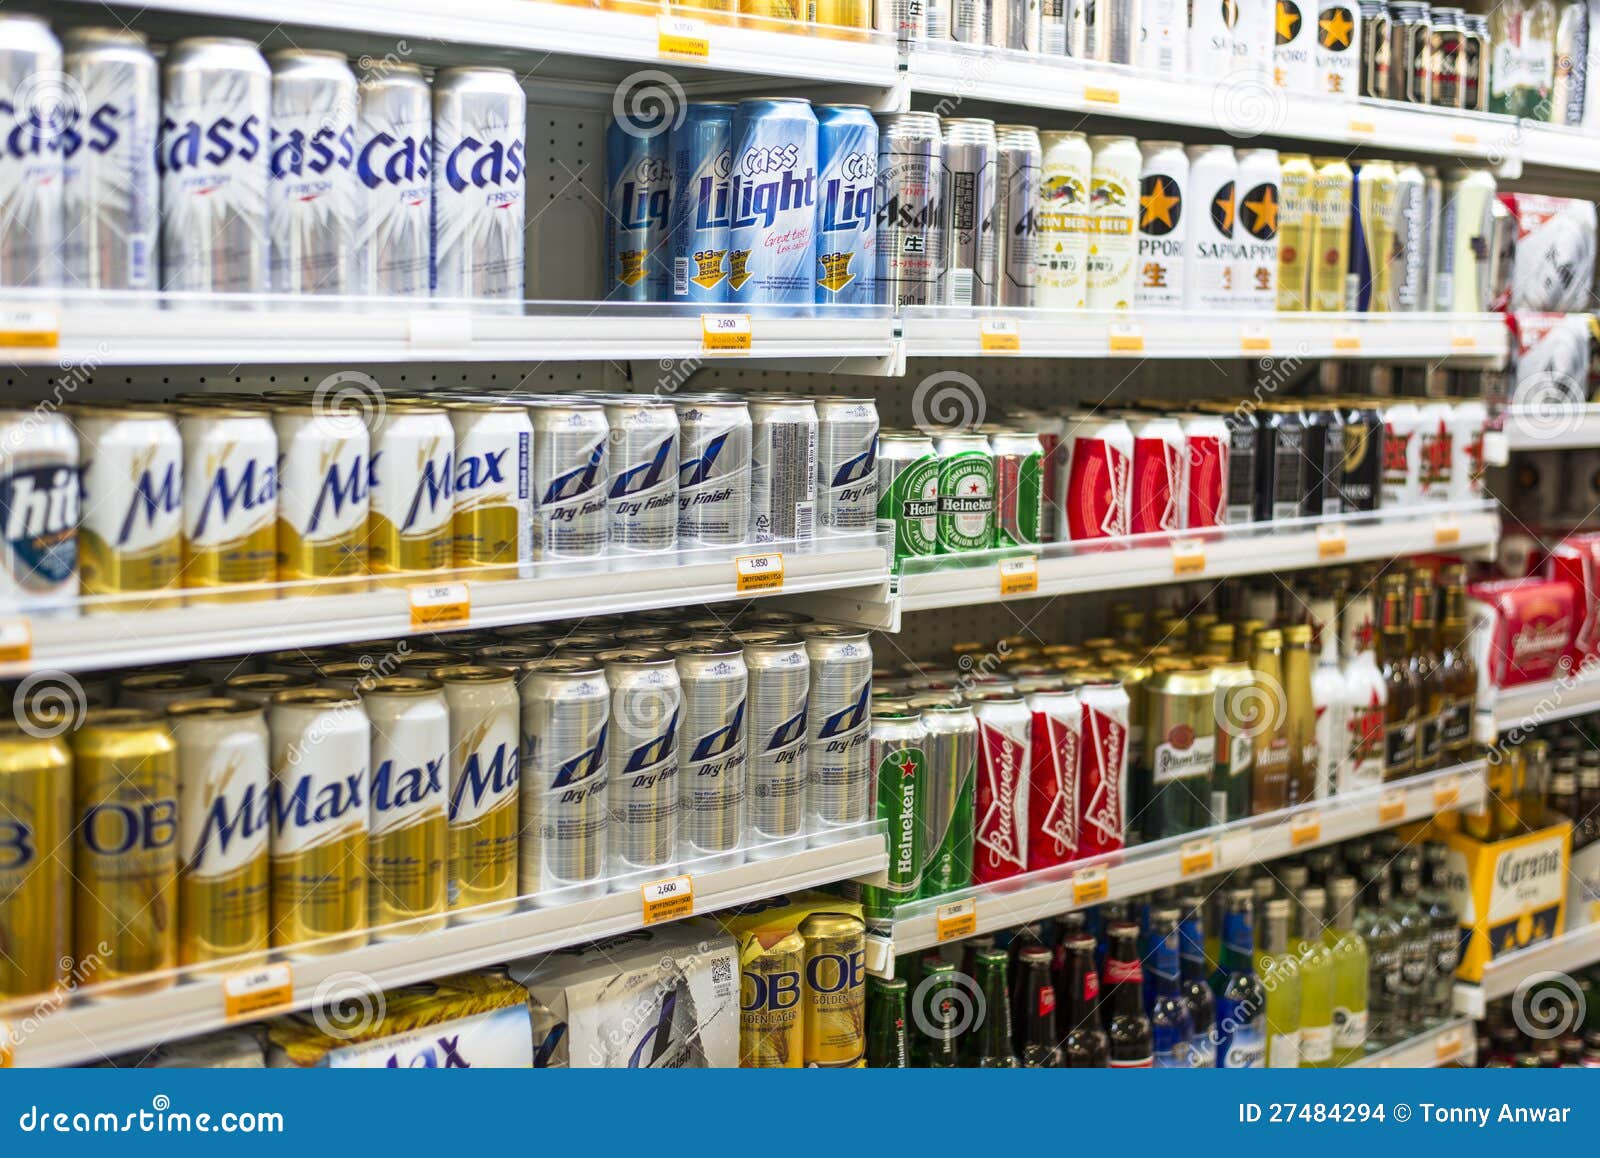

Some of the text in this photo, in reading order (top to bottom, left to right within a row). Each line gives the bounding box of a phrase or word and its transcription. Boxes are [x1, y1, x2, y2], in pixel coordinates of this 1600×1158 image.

[730, 167, 817, 231] Light
[904, 235, 924, 252] 生
[1142, 261, 1168, 288] 生
[717, 319, 736, 329] 2,600
[693, 487, 731, 505] Finish
[839, 488, 860, 502] Dry
[616, 500, 641, 517] Dry
[942, 498, 993, 512] Heineken
[551, 505, 576, 522] Dry
[750, 558, 769, 568] 1,850
[825, 739, 848, 753] Dry
[774, 749, 795, 764] Dry
[697, 763, 721, 778] Dry
[631, 773, 656, 789] Dry
[560, 788, 586, 804] Dry
[83, 799, 178, 857] OB
[898, 783, 915, 873] Heineken
[657, 882, 677, 895] 2,600
[806, 949, 865, 994] OB
[813, 994, 848, 1006] GOLDEN
